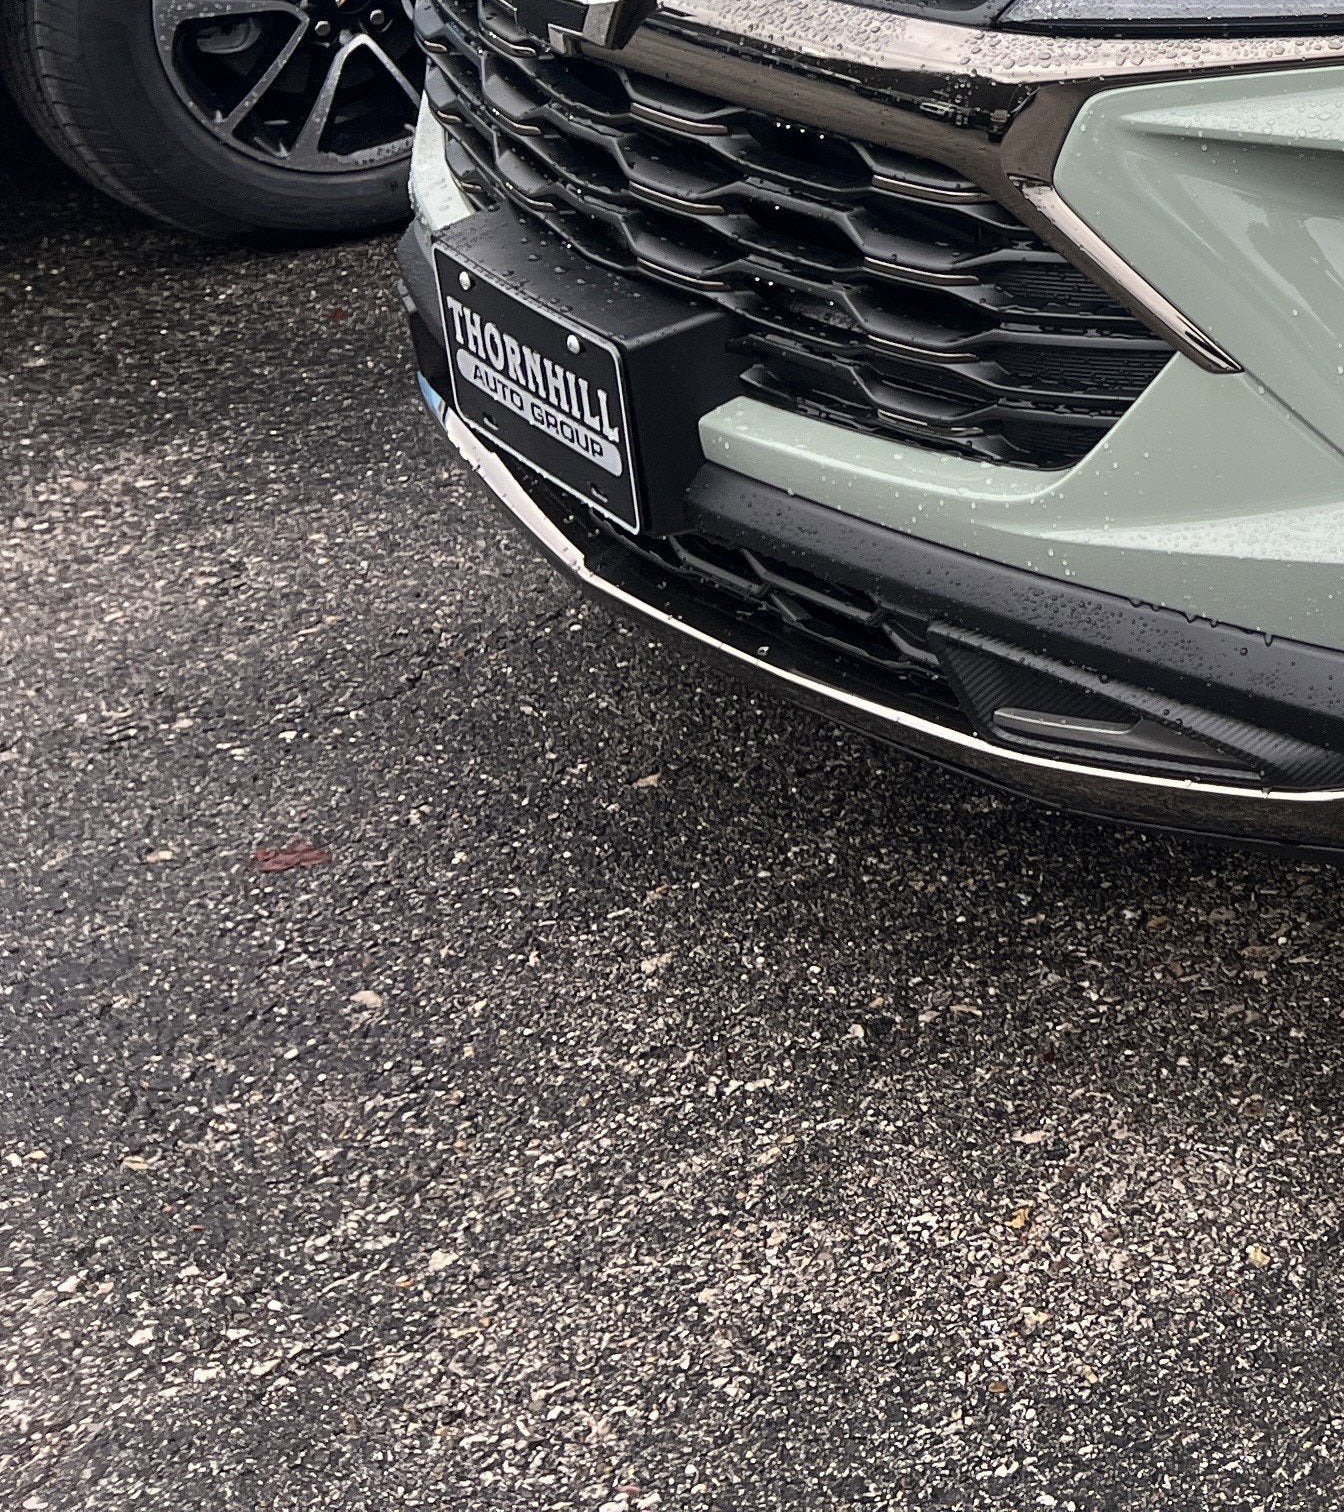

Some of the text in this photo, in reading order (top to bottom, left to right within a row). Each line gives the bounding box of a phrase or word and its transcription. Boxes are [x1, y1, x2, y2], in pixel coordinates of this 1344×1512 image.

[446, 295, 620, 443] THORNHILL
[473, 363, 604, 459] AUTO GROUP
